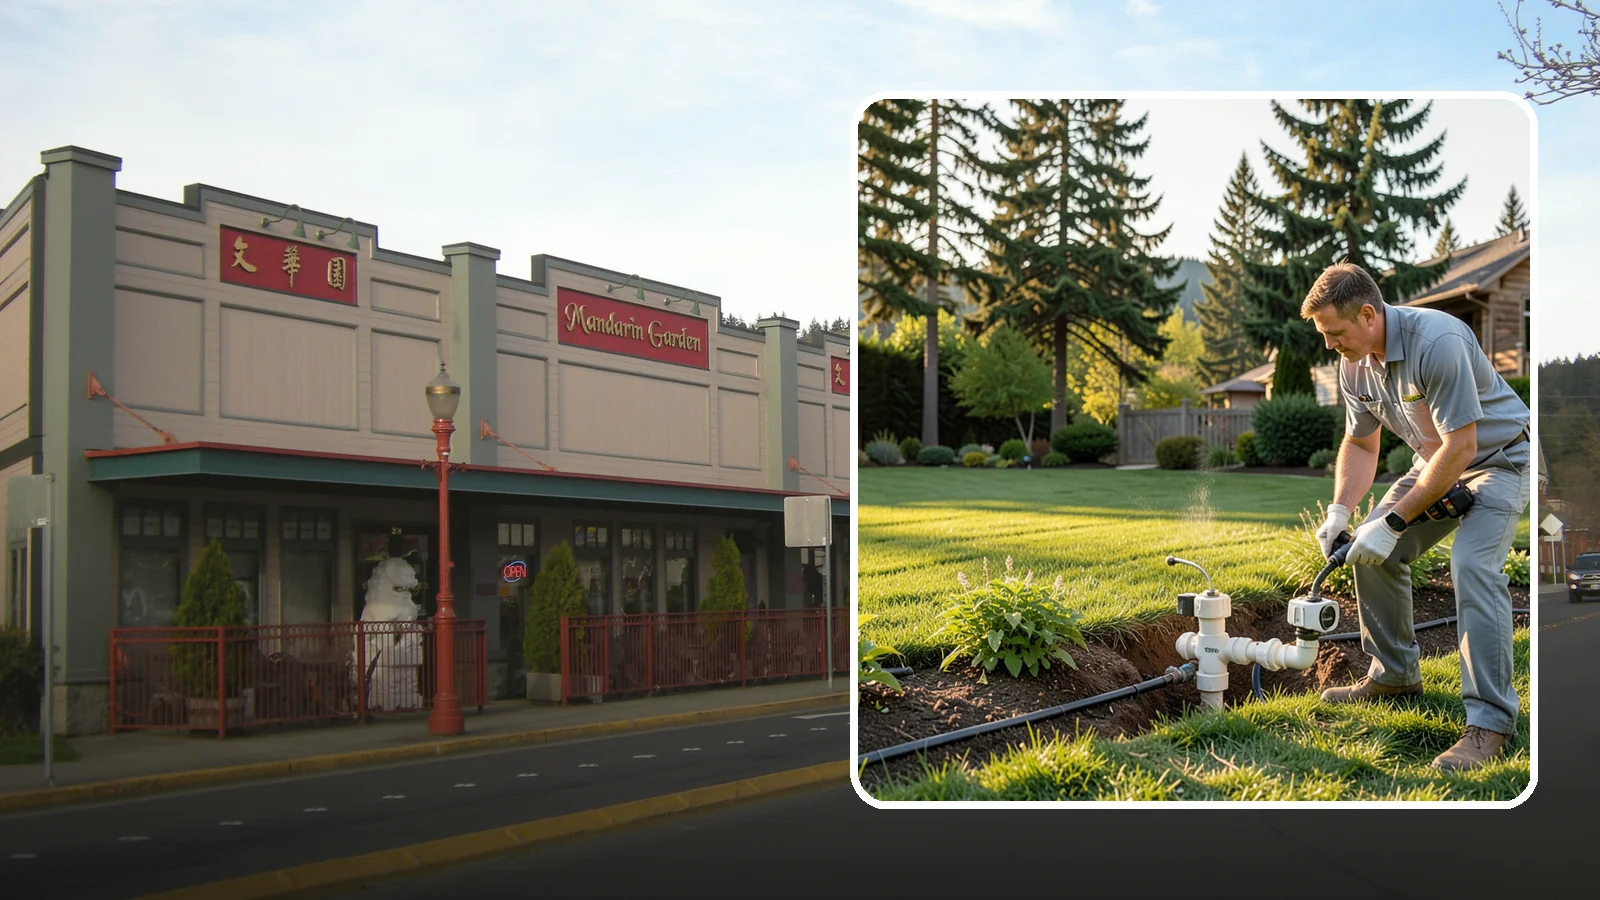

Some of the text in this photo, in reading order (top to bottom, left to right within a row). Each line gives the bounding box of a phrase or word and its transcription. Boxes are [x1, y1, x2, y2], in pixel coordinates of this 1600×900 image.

[565, 302, 701, 352] Mandarin Garden
[503, 565, 527, 578] OPEN
